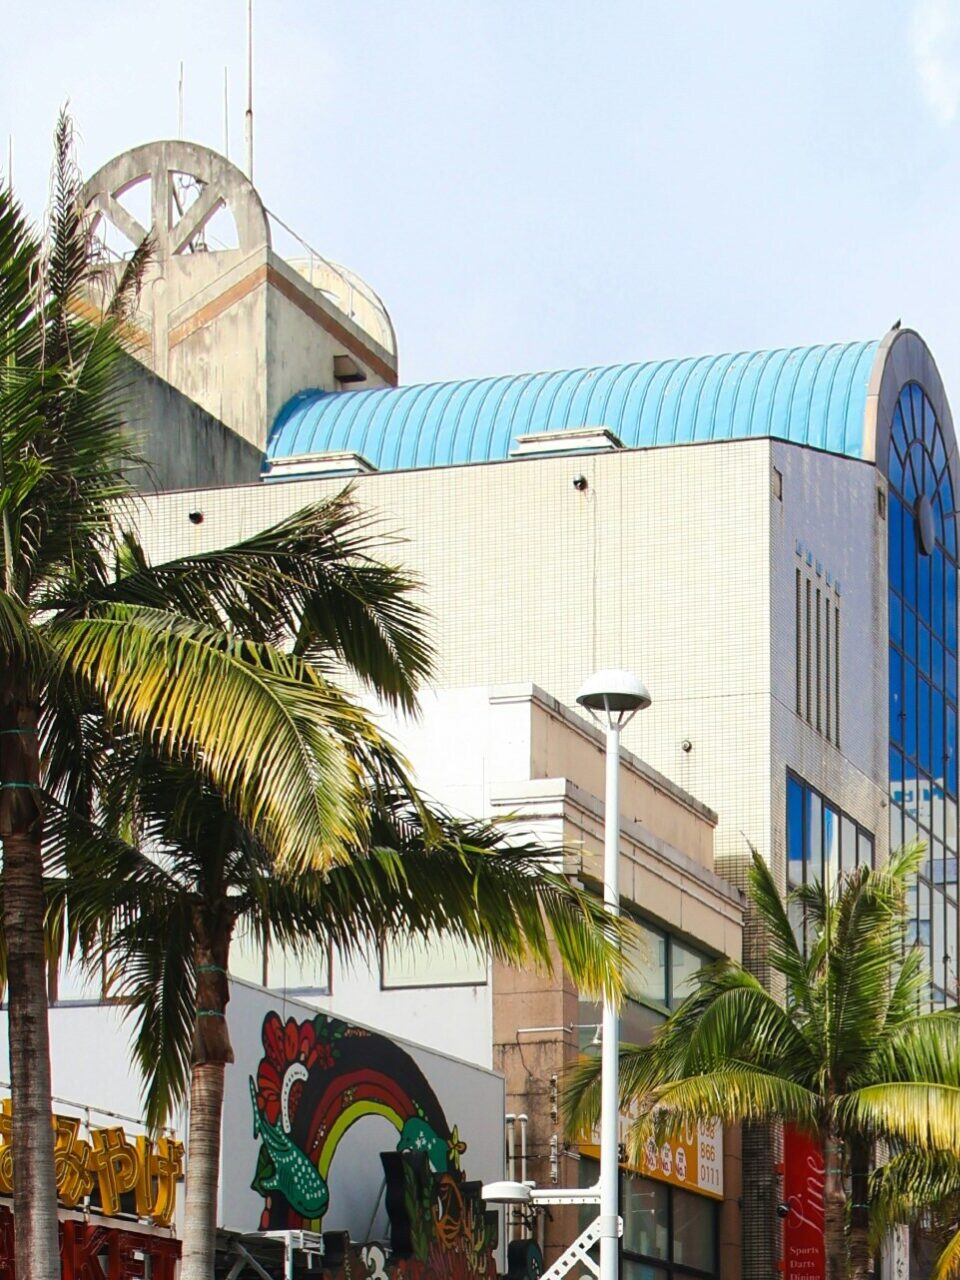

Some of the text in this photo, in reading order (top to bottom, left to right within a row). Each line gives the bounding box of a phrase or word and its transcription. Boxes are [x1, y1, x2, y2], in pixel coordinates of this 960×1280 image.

[700, 1142, 716, 1162] 866
[700, 1164, 720, 1186] 0111
[790, 1246, 819, 1255] Sports
[790, 1260, 816, 1268] Darts
